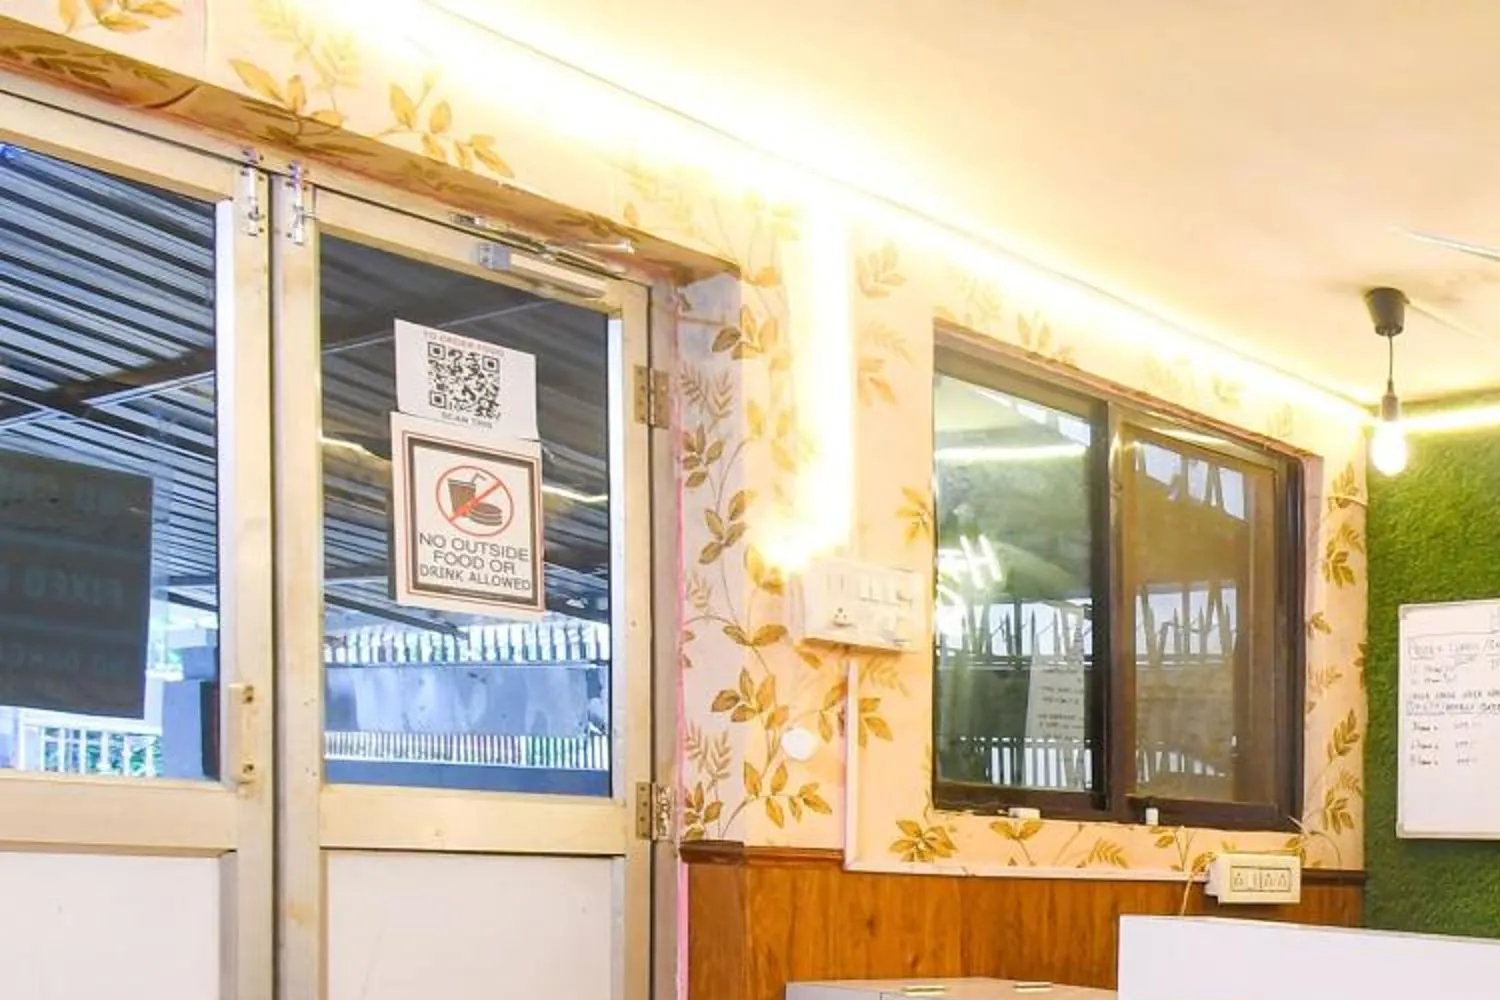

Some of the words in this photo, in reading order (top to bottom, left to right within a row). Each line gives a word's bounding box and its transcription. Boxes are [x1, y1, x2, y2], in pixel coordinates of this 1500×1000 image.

[419, 532, 447, 549] NO
[451, 537, 530, 562] OUTSIDE
[433, 550, 485, 570] FOOD
[489, 559, 515, 575] OR
[420, 563, 464, 582] DRINK
[468, 571, 531, 591] ALLOWED
